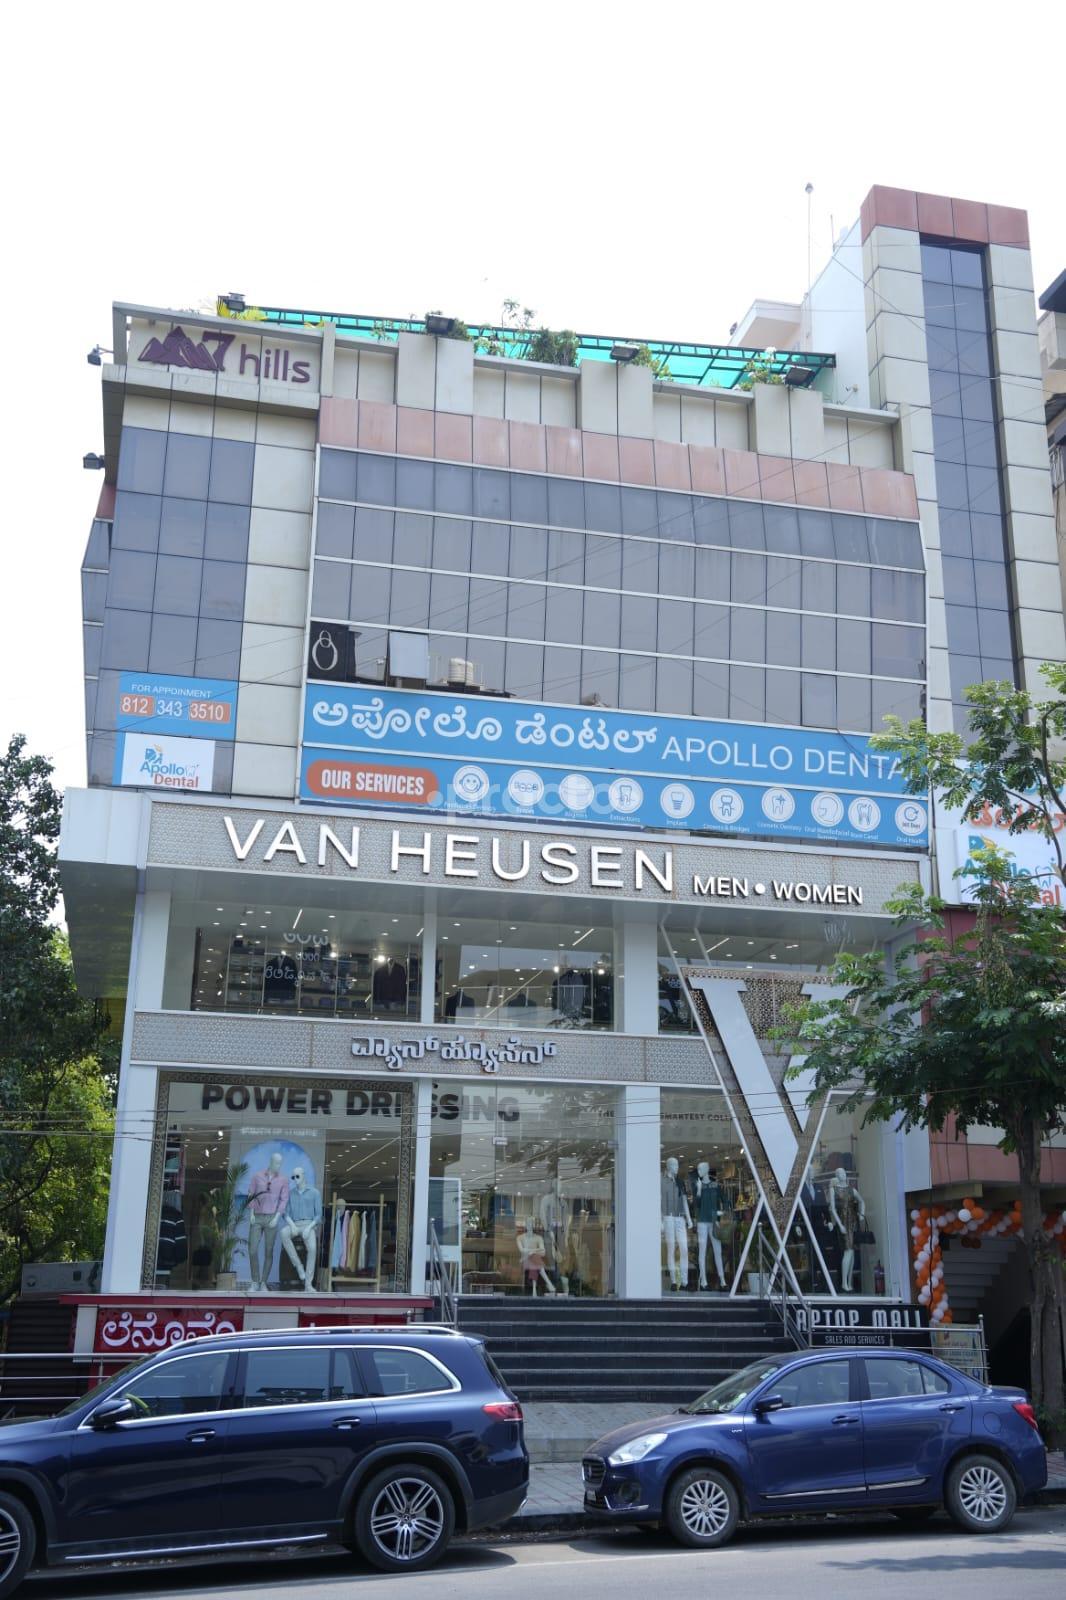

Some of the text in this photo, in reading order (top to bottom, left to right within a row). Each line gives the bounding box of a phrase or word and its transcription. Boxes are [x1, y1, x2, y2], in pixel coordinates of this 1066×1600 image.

[239, 343, 310, 383] hills
[131, 684, 150, 692] FOR
[121, 696, 224, 721] 812 343 3510
[661, 736, 793, 770] APOLLO
[140, 761, 185, 777] Apollo
[154, 773, 199, 788] Dental
[321, 769, 425, 796] OUR SERVICES
[223, 816, 674, 892] VAN HEUSEN
[693, 875, 863, 905] MEN WOMEN
[201, 1084, 333, 1115] POWER
